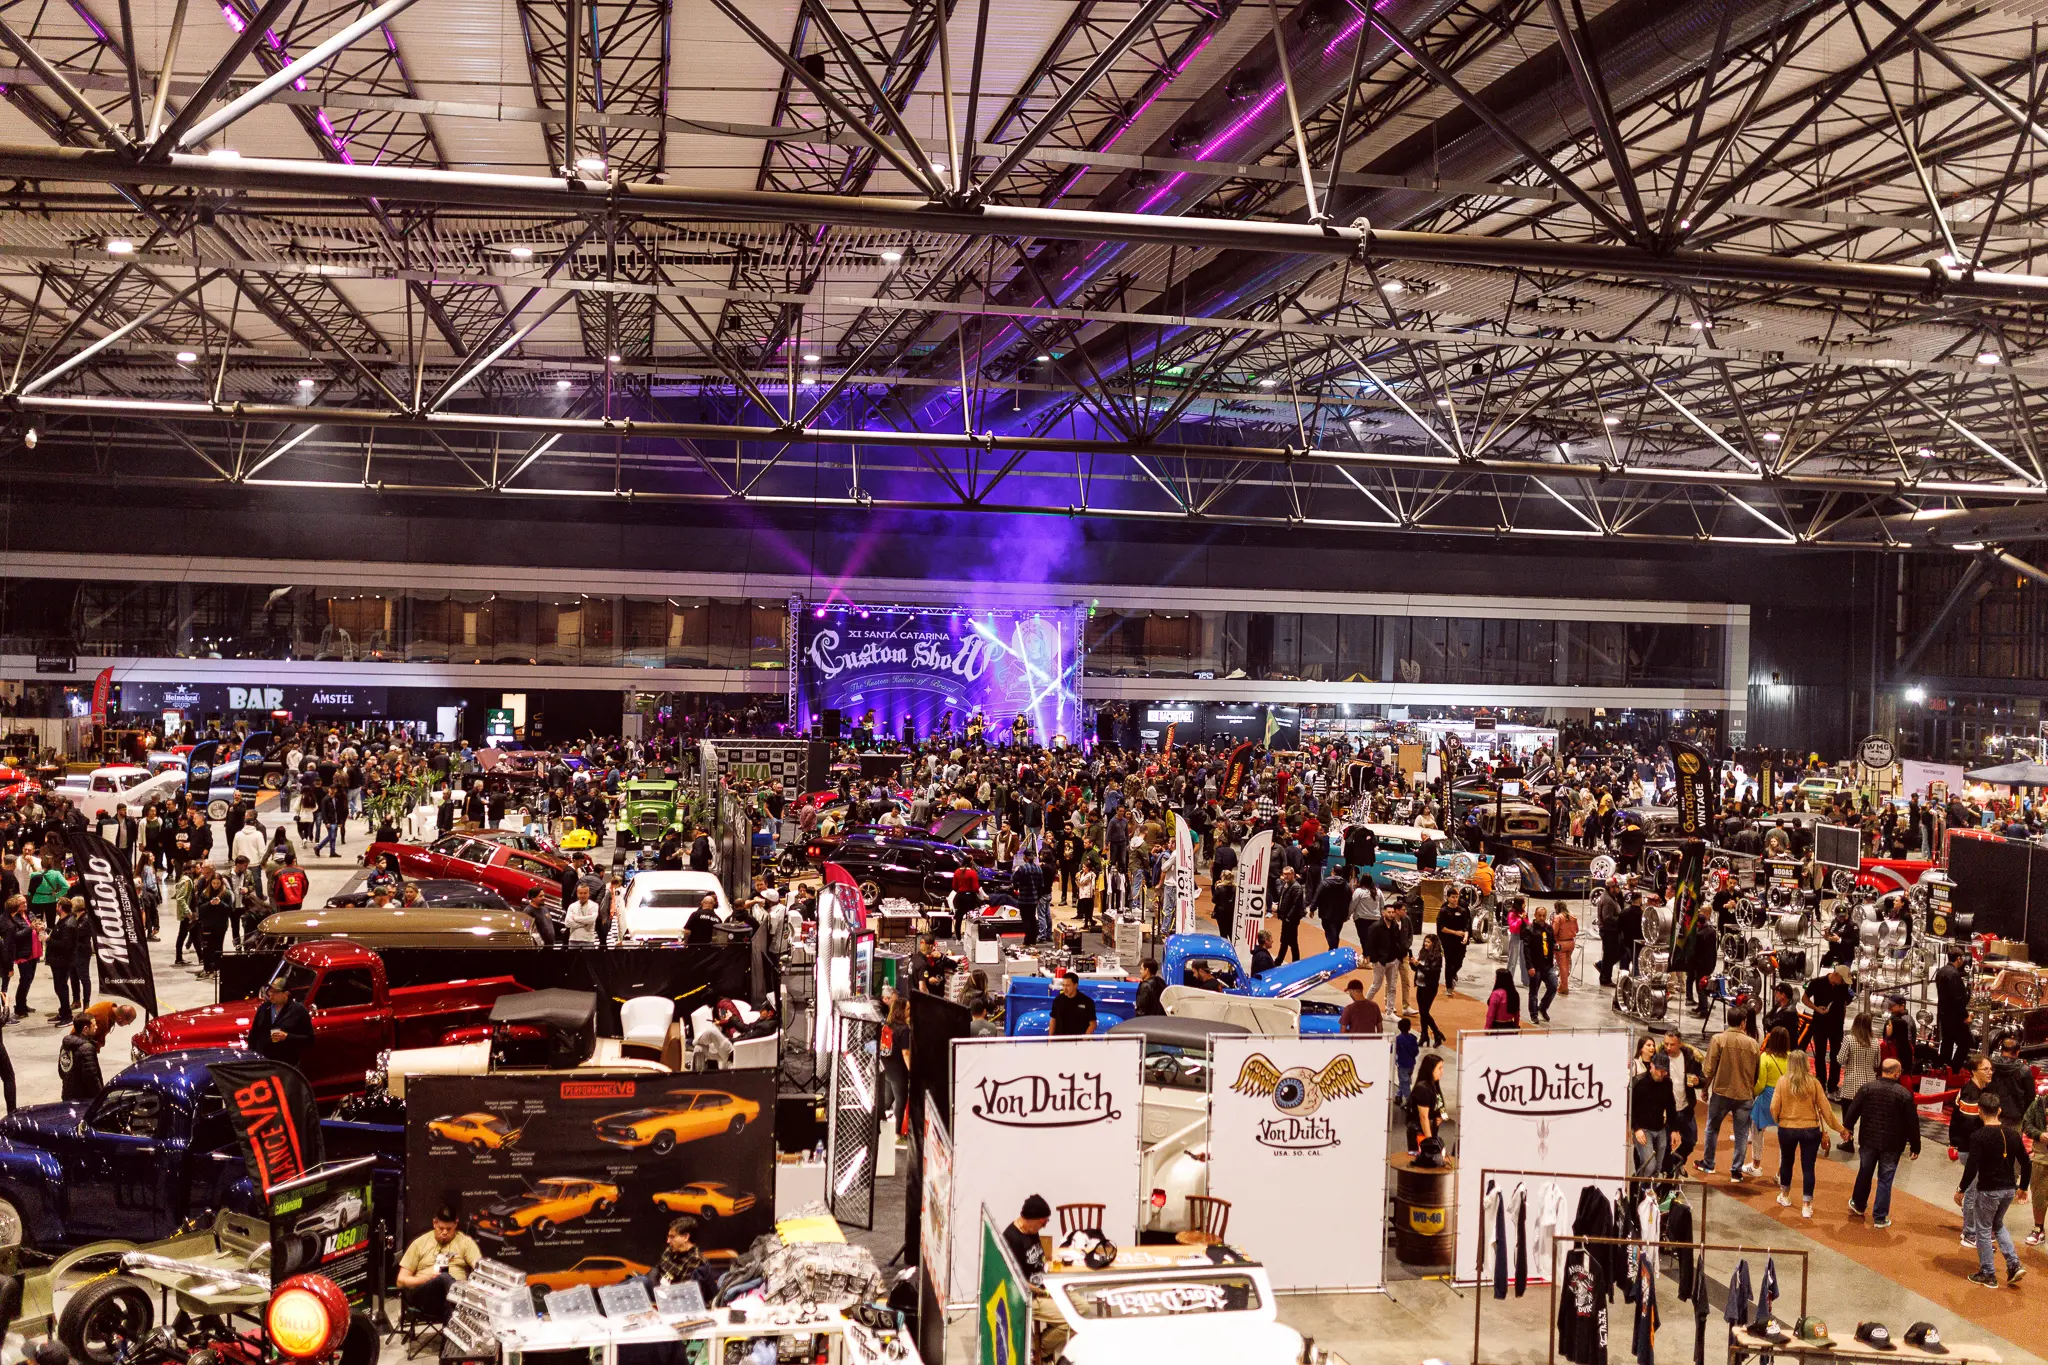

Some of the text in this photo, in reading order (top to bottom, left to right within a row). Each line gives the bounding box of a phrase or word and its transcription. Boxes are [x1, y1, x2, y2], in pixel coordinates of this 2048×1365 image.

[849, 630, 949, 641] XI SANTA CATARINA
[805, 628, 909, 679] Custom
[165, 693, 198, 702] Heineken
[229, 687, 284, 710] BAR
[311, 693, 354, 704] AMSTEL
[1683, 775, 1696, 834] Garagem
[1698, 783, 1707, 828] VINTAGE
[84, 855, 130, 964] Matiolo
[1233, 863, 1249, 947] imports
[1249, 886, 1265, 919] 101
[974, 1072, 1113, 1117] Von Dutch
[1479, 1062, 1604, 1106] Von Dutch
[233, 1079, 278, 1137] V8
[1258, 1117, 1336, 1143] Von Dutch
[1412, 1211, 1442, 1224] WD-40
[1105, 1287, 1228, 1315] Von Dutch
[278, 1315, 315, 1332] SHELL
